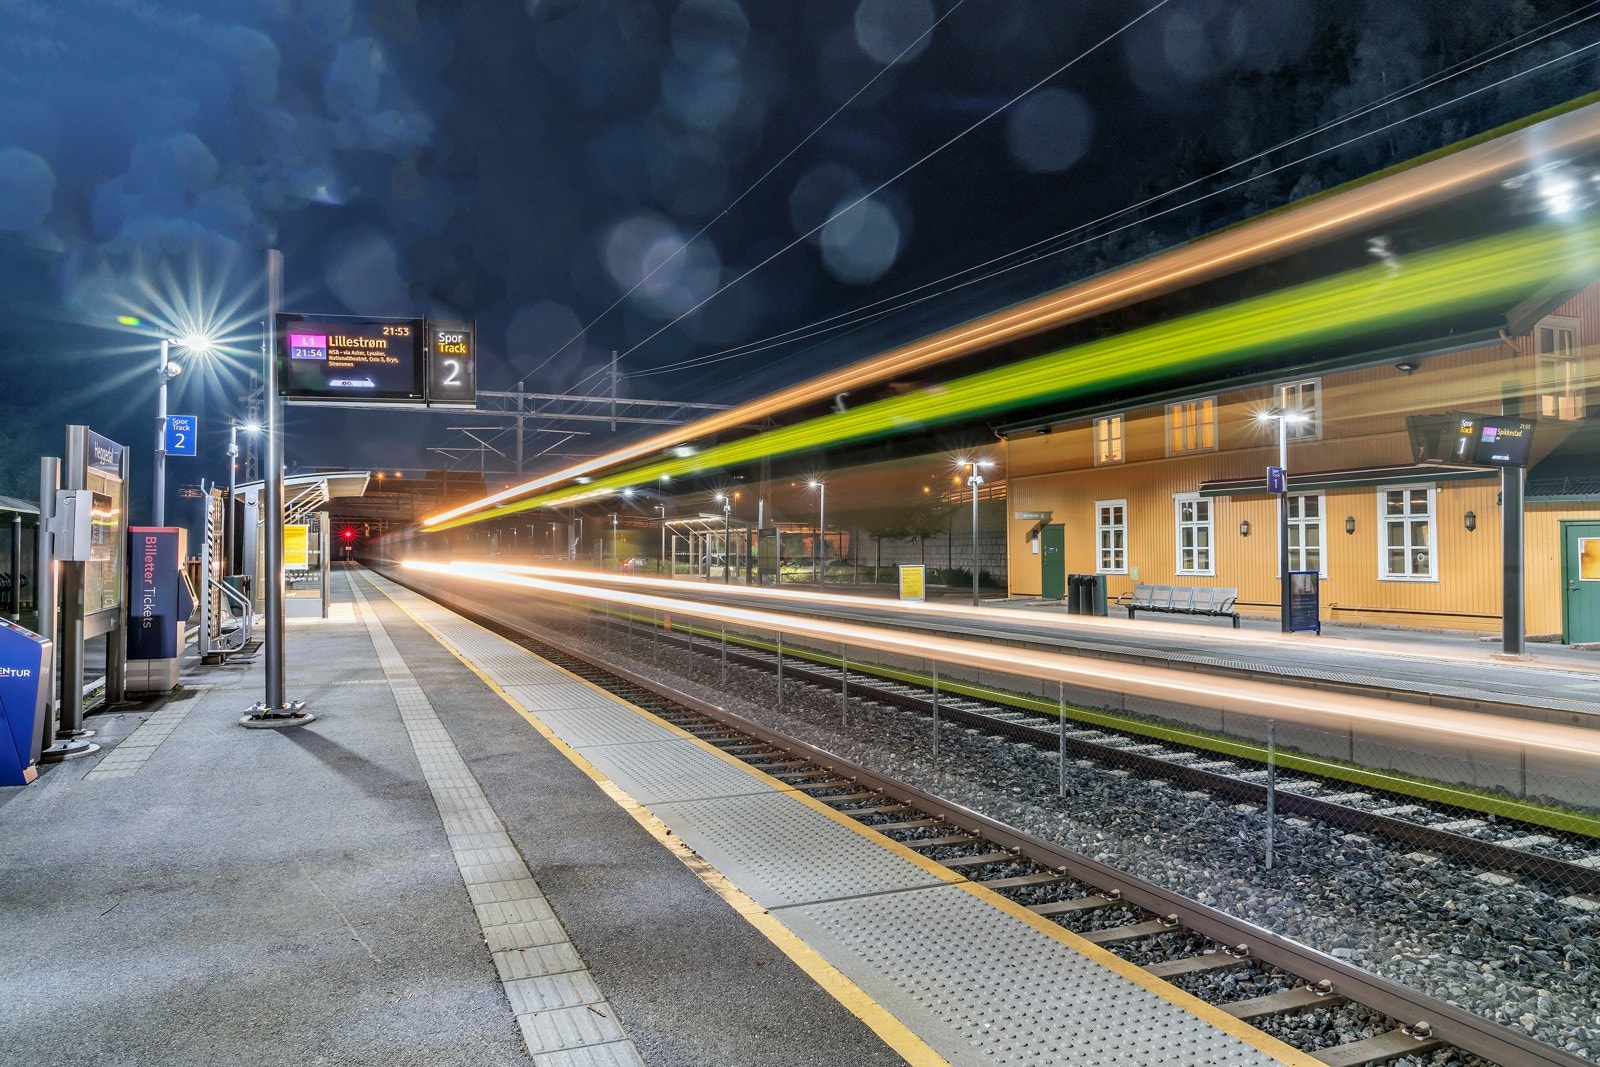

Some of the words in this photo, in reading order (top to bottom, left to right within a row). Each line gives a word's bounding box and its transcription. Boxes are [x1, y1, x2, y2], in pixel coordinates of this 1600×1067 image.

[383, 327, 409, 336] 21:53
[302, 336, 315, 346] L1
[329, 336, 387, 349] Lillestrøm
[439, 332, 462, 344] Spor
[295, 348, 322, 357] 21:54
[438, 342, 467, 353] Track
[443, 360, 460, 385] 2
[172, 418, 188, 426] Spor
[1461, 420, 1473, 428] Spor
[174, 433, 185, 449] 2
[1460, 437, 1467, 454] 1
[95, 440, 113, 465] Heggedal
[1273, 478, 1278, 489] 1
[144, 536, 157, 584] Billetter
[143, 587, 156, 628] Tickets
